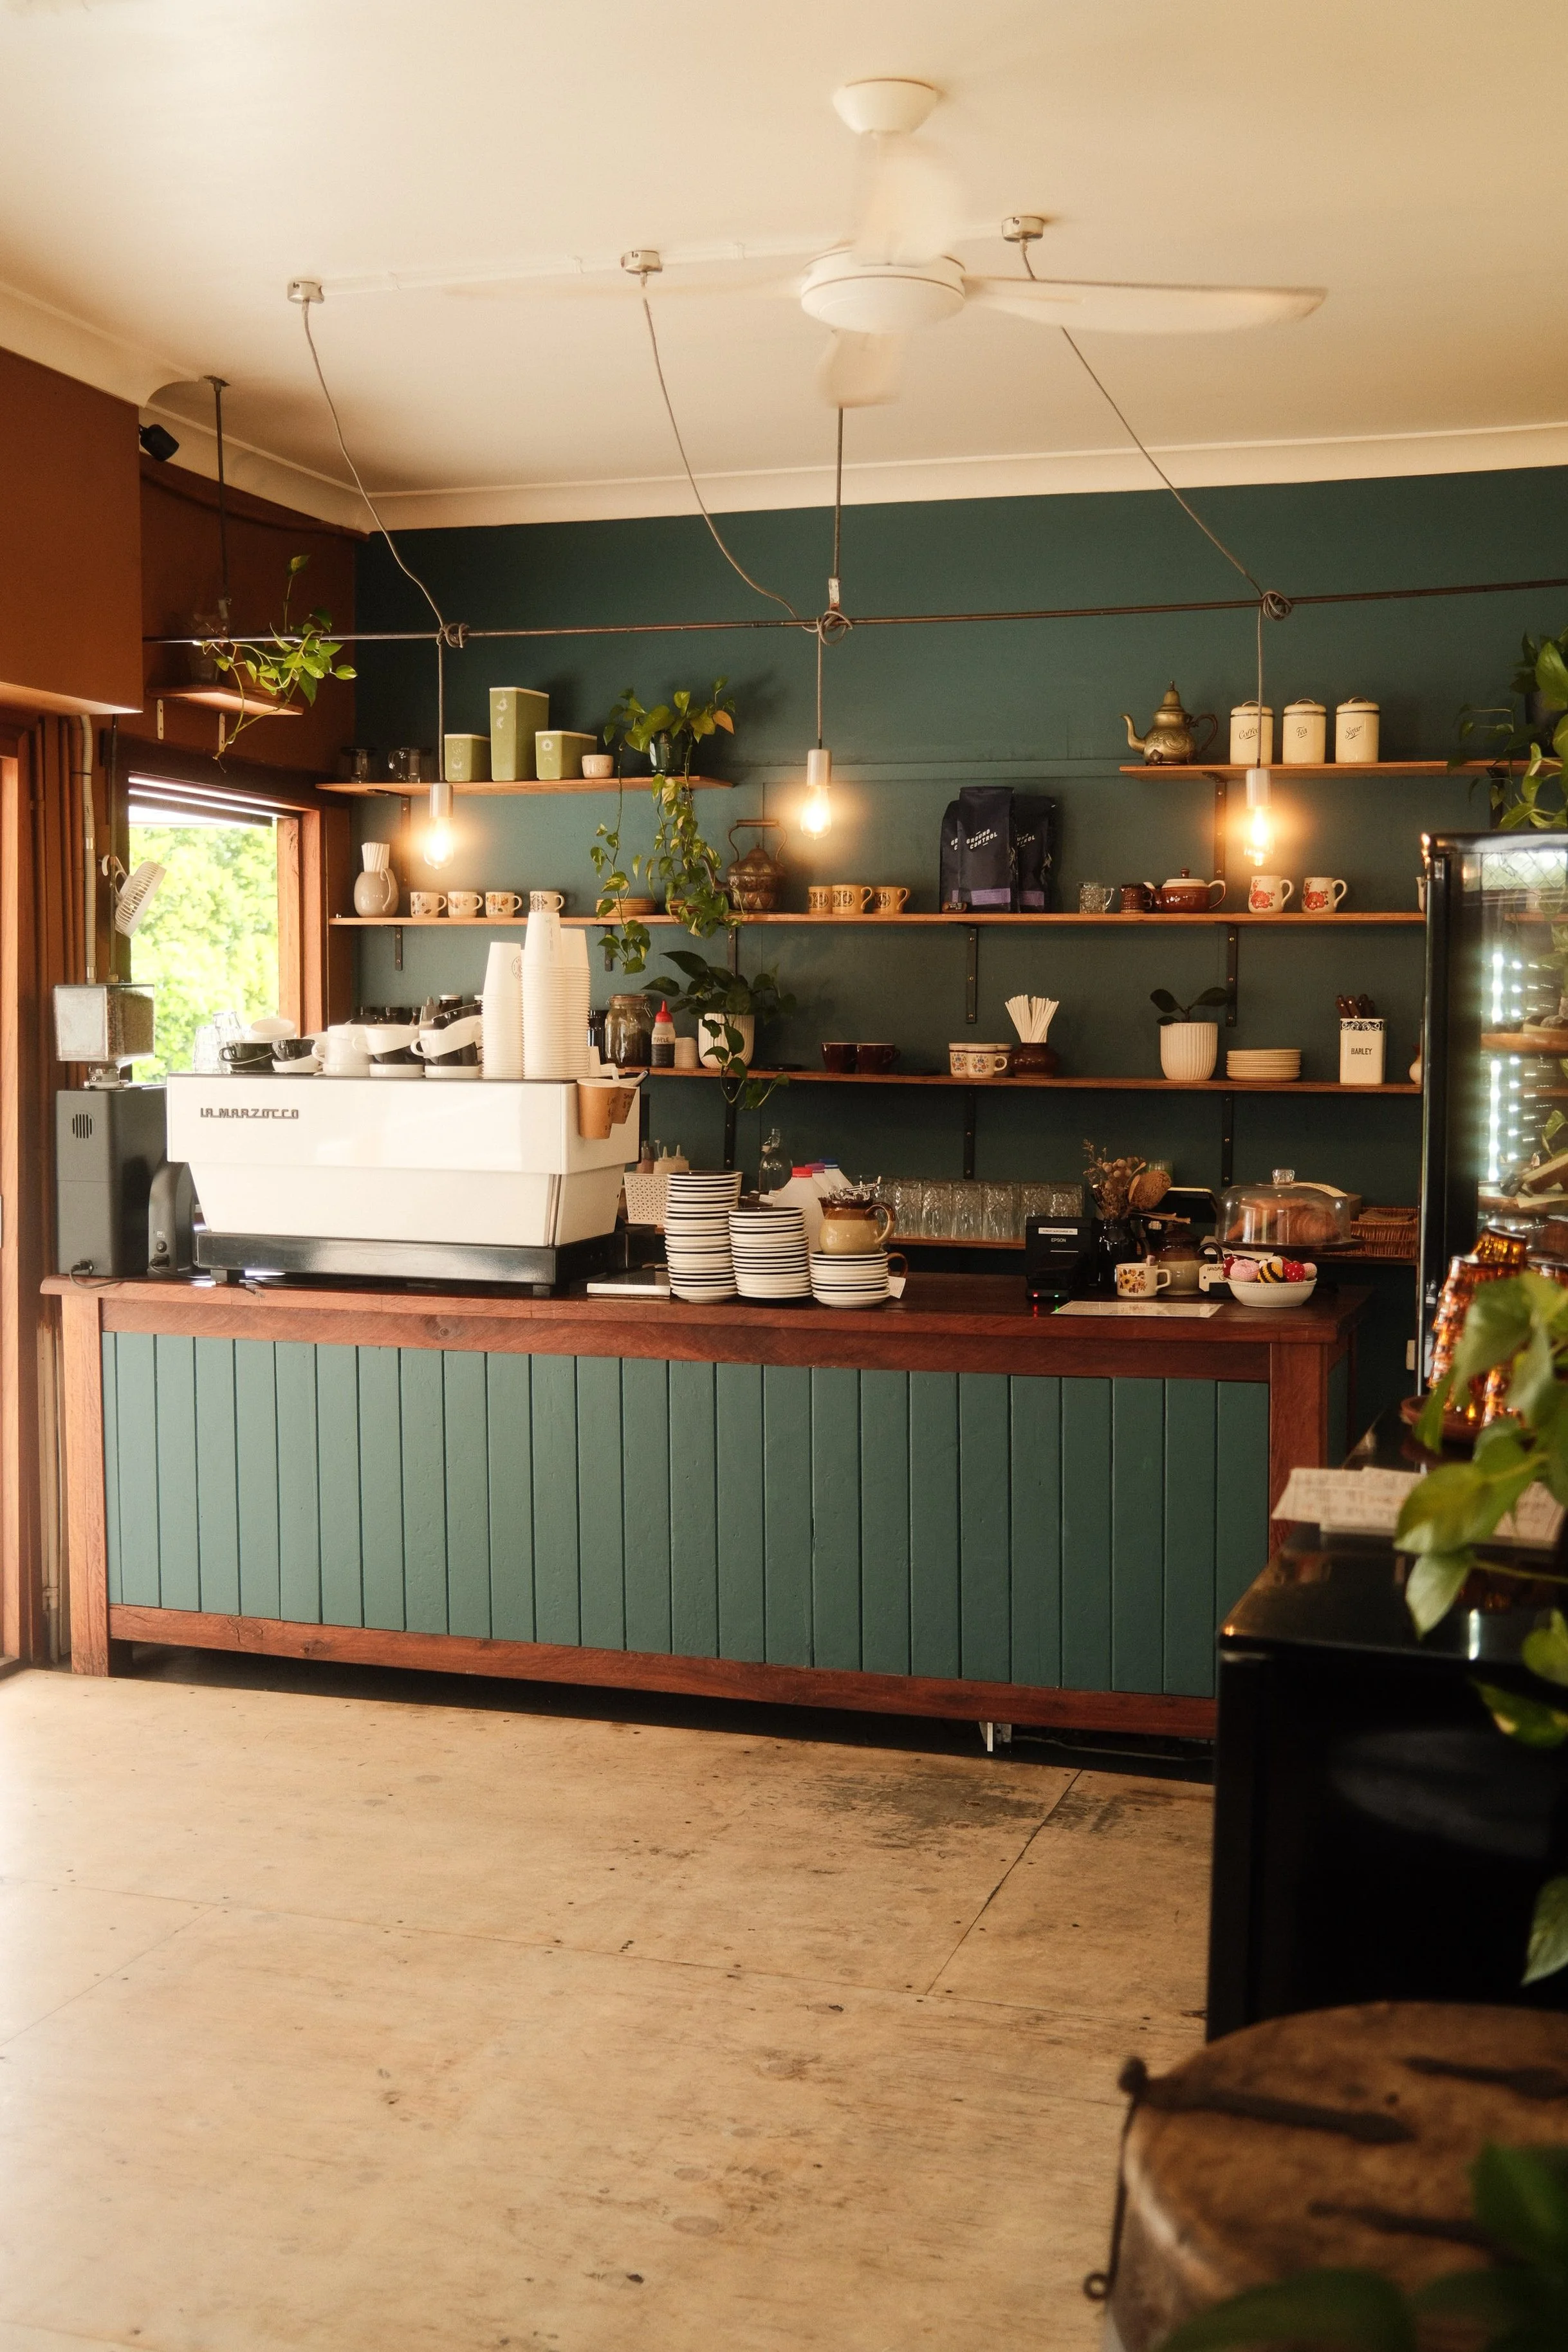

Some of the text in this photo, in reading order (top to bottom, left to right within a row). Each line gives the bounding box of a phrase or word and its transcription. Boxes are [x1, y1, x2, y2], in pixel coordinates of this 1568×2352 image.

[1296, 727, 1307, 737] Tea
[1345, 726, 1362, 739] Sugar
[966, 829, 990, 844] GROUND
[970, 832, 998, 849] CONTROL
[200, 1107, 299, 1119] LA MARZOCCO
